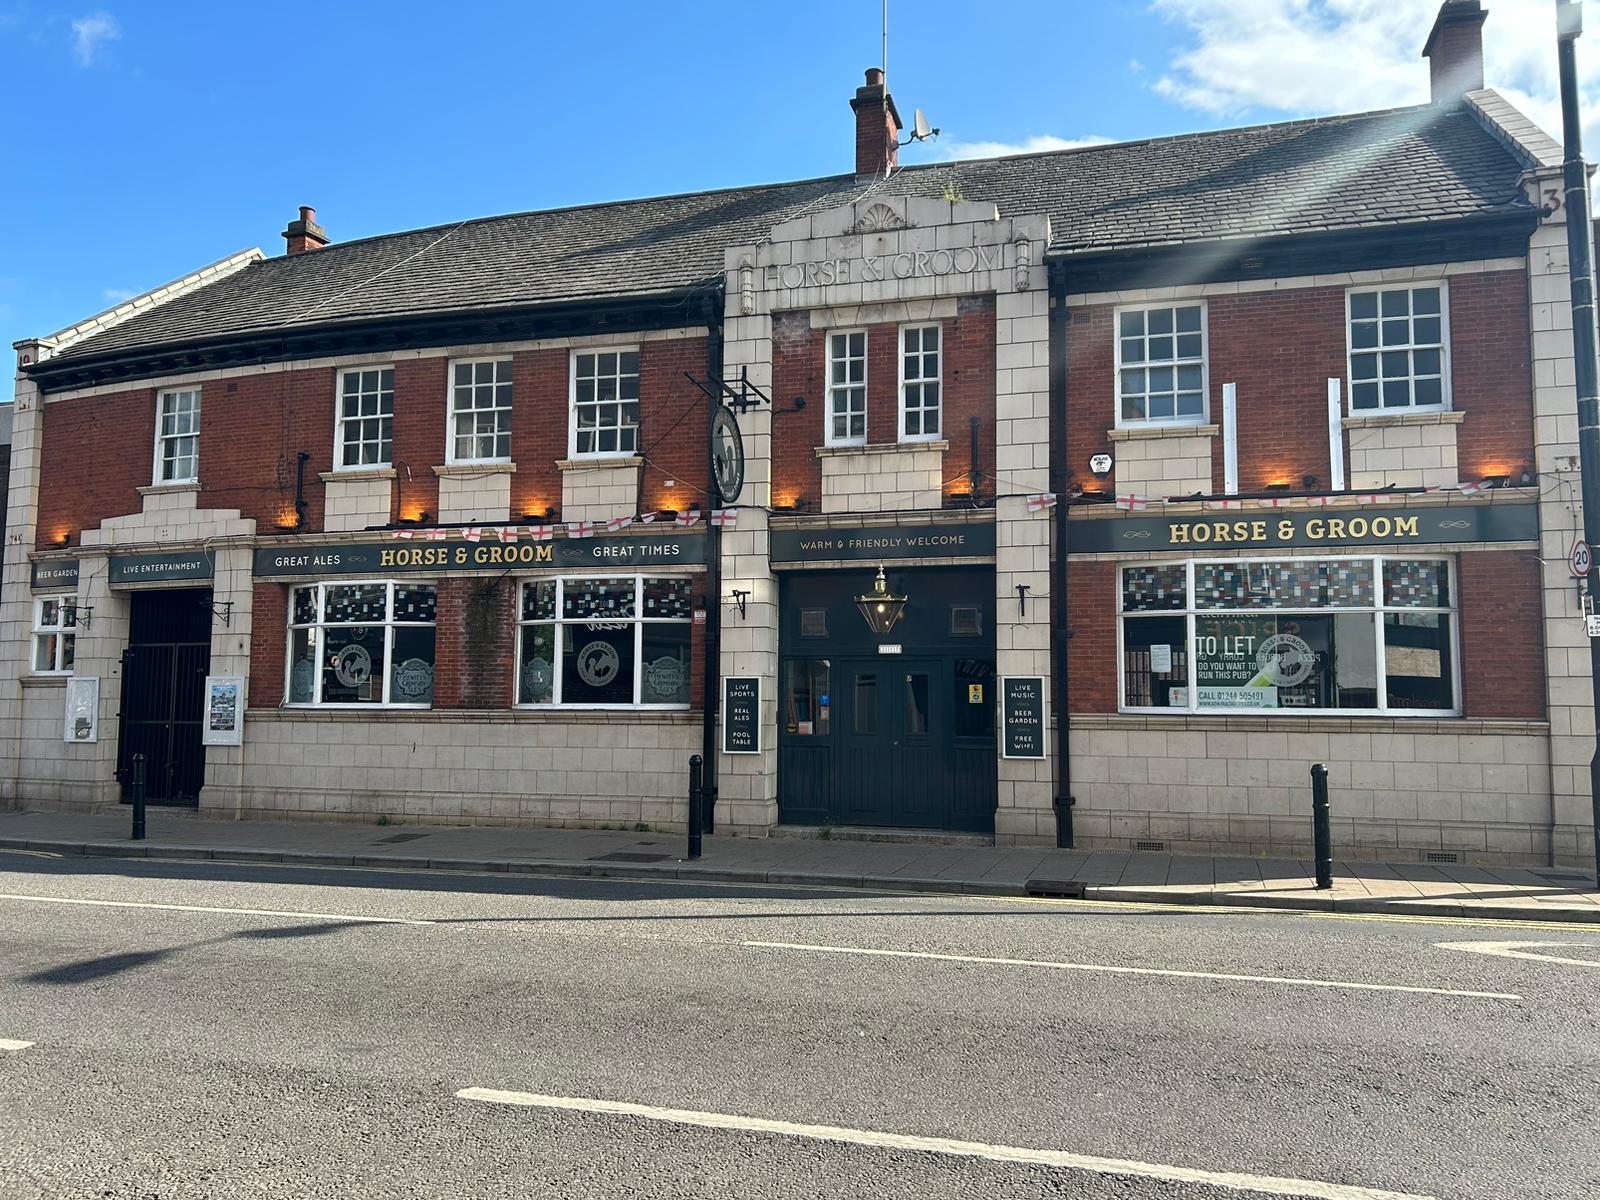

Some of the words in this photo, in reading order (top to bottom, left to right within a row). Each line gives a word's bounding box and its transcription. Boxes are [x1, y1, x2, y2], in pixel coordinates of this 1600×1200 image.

[764, 259, 850, 289] HORSE
[862, 256, 884, 282] &
[893, 245, 1004, 279] GROOM
[1169, 521, 1267, 543] HORSE
[1277, 520, 1295, 540] &
[1305, 516, 1419, 539] GROOM
[800, 540, 832, 550] WARM
[837, 540, 844, 549] &
[849, 538, 902, 548] FRIENDLY
[906, 535, 965, 546] WELCOME
[380, 548, 448, 566] HORSE
[455, 547, 468, 563] &
[474, 545, 554, 563] GROOM
[593, 546, 634, 557] GREAT
[640, 544, 680, 556] TIMES
[275, 556, 309, 567] GREAT
[313, 555, 341, 566] ALES
[1575, 551, 1588, 565] 20
[123, 565, 140, 573] LIVE
[141, 561, 201, 572] ENTERTAINMENT
[36, 570, 52, 579] BEER
[53, 569, 78, 578] GARDEN
[1196, 636, 1217, 656] TO
[1224, 636, 1256, 656] LET
[1198, 662, 1208, 671] DO
[1209, 662, 1224, 671] YOU
[1225, 662, 1246, 671] WANT
[1248, 662, 1257, 671] TO
[1198, 671, 1213, 679] RUN
[1215, 671, 1231, 679] THIS
[1232, 671, 1252, 679] PUB?
[1198, 691, 1216, 700] CALL
